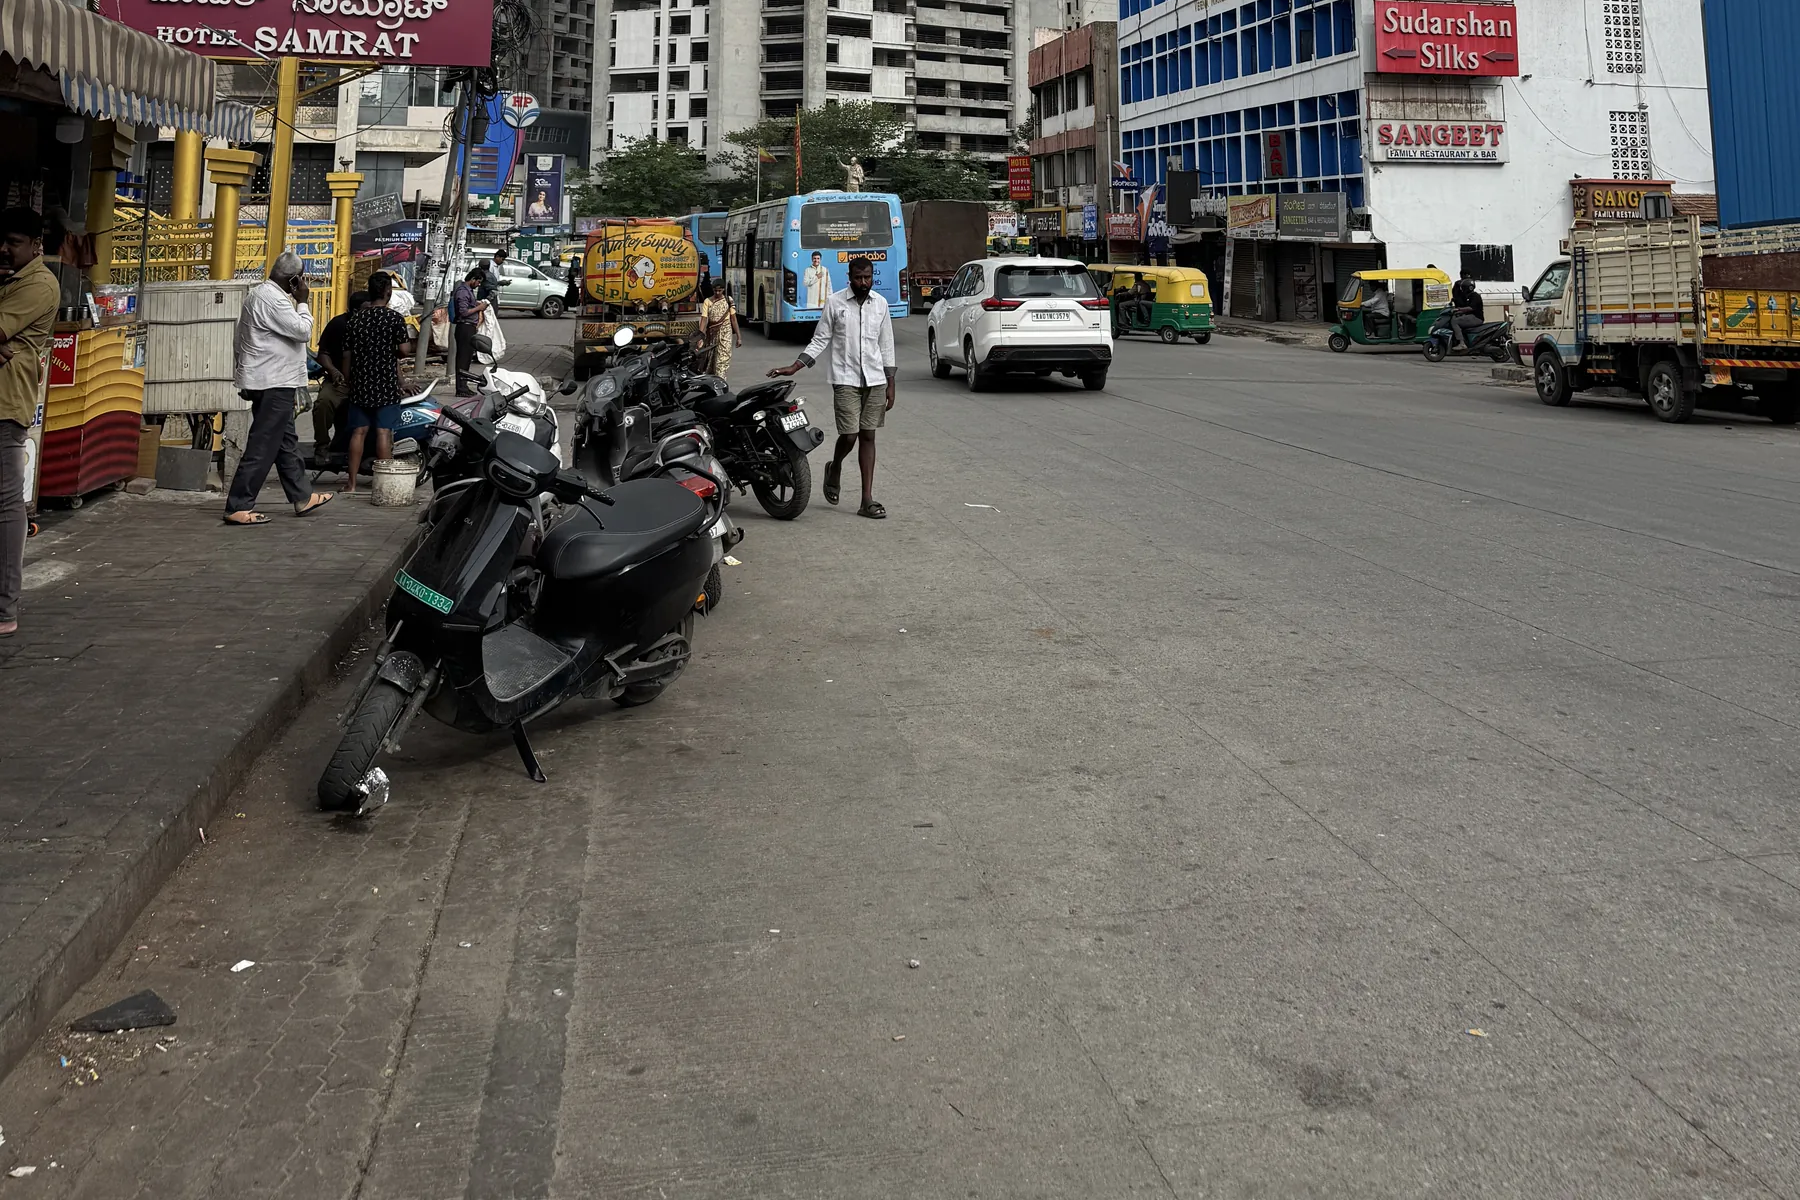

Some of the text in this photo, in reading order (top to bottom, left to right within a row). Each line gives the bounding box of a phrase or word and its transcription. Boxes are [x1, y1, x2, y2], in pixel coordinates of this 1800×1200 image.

[1383, 7, 1513, 38] Sudarshan
[156, 26, 420, 58] HOTEL SAMRAT
[1420, 42, 1480, 70] Silks
[512, 96, 533, 108] HP
[1378, 123, 1504, 147] SANGEET
[1010, 158, 1030, 167] HOTEL
[1269, 133, 1283, 176] BAR
[1389, 150, 1417, 158] FAMILY
[1419, 150, 1471, 158] RESTAURANT
[1480, 151, 1497, 159] BAR
[1594, 210, 1642, 219] FAMILY RESTAU
[640, 233, 689, 257] Supply
[665, 281, 694, 299] Coated
[463, 517, 474, 526] OLA
